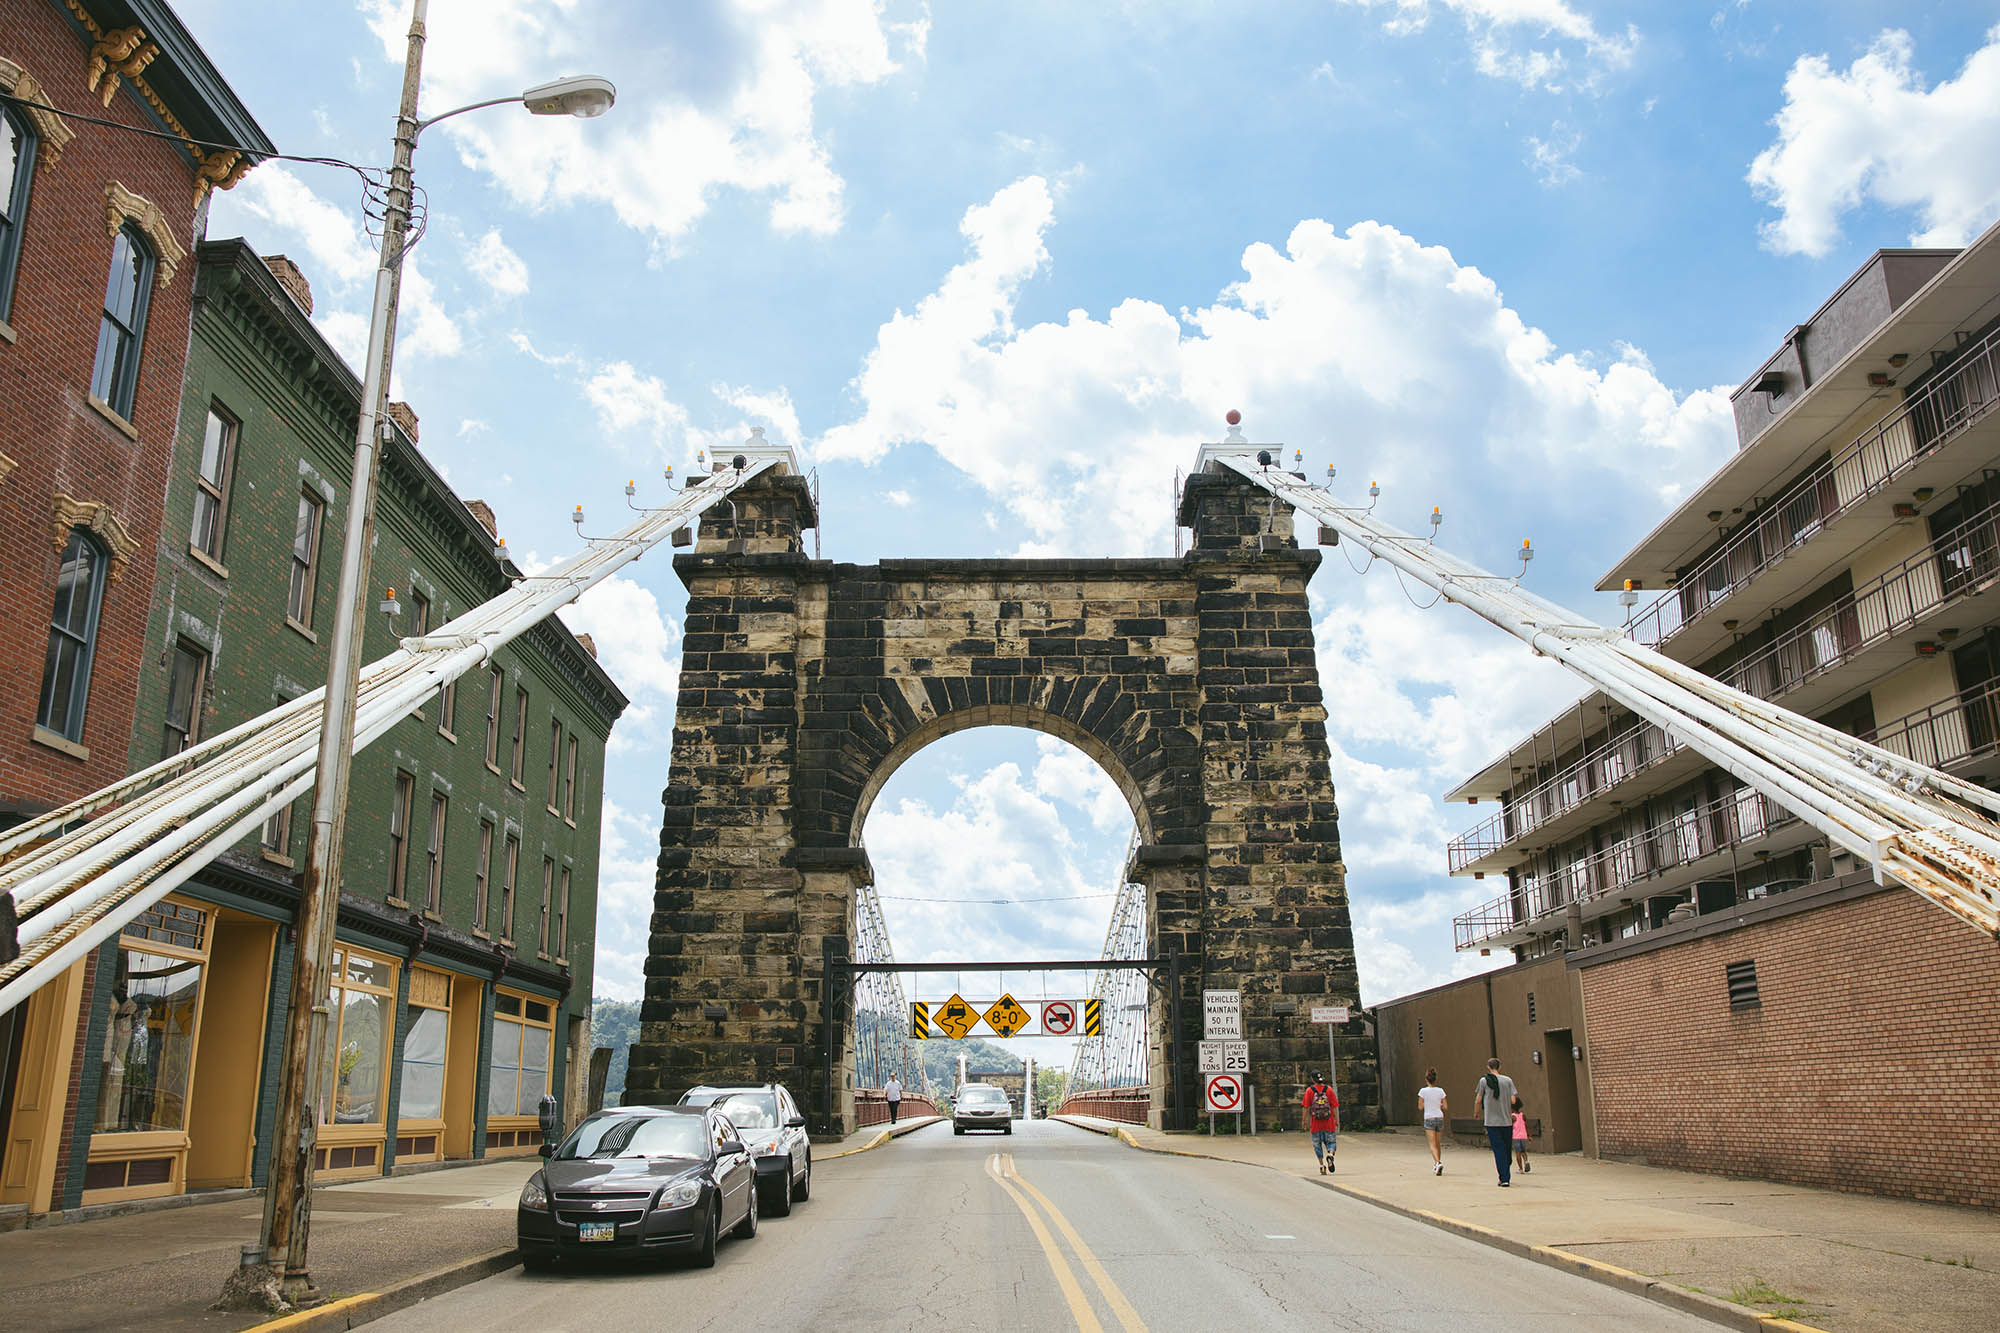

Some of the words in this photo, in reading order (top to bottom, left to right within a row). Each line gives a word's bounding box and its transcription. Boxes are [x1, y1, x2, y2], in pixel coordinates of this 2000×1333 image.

[1207, 995, 1239, 1003] VEHICLES
[1212, 1016, 1221, 1024] 50
[1225, 1016, 1234, 1024] FT
[1207, 1027, 1239, 1035] INTERVAL
[1226, 1057, 1247, 1069] 25
